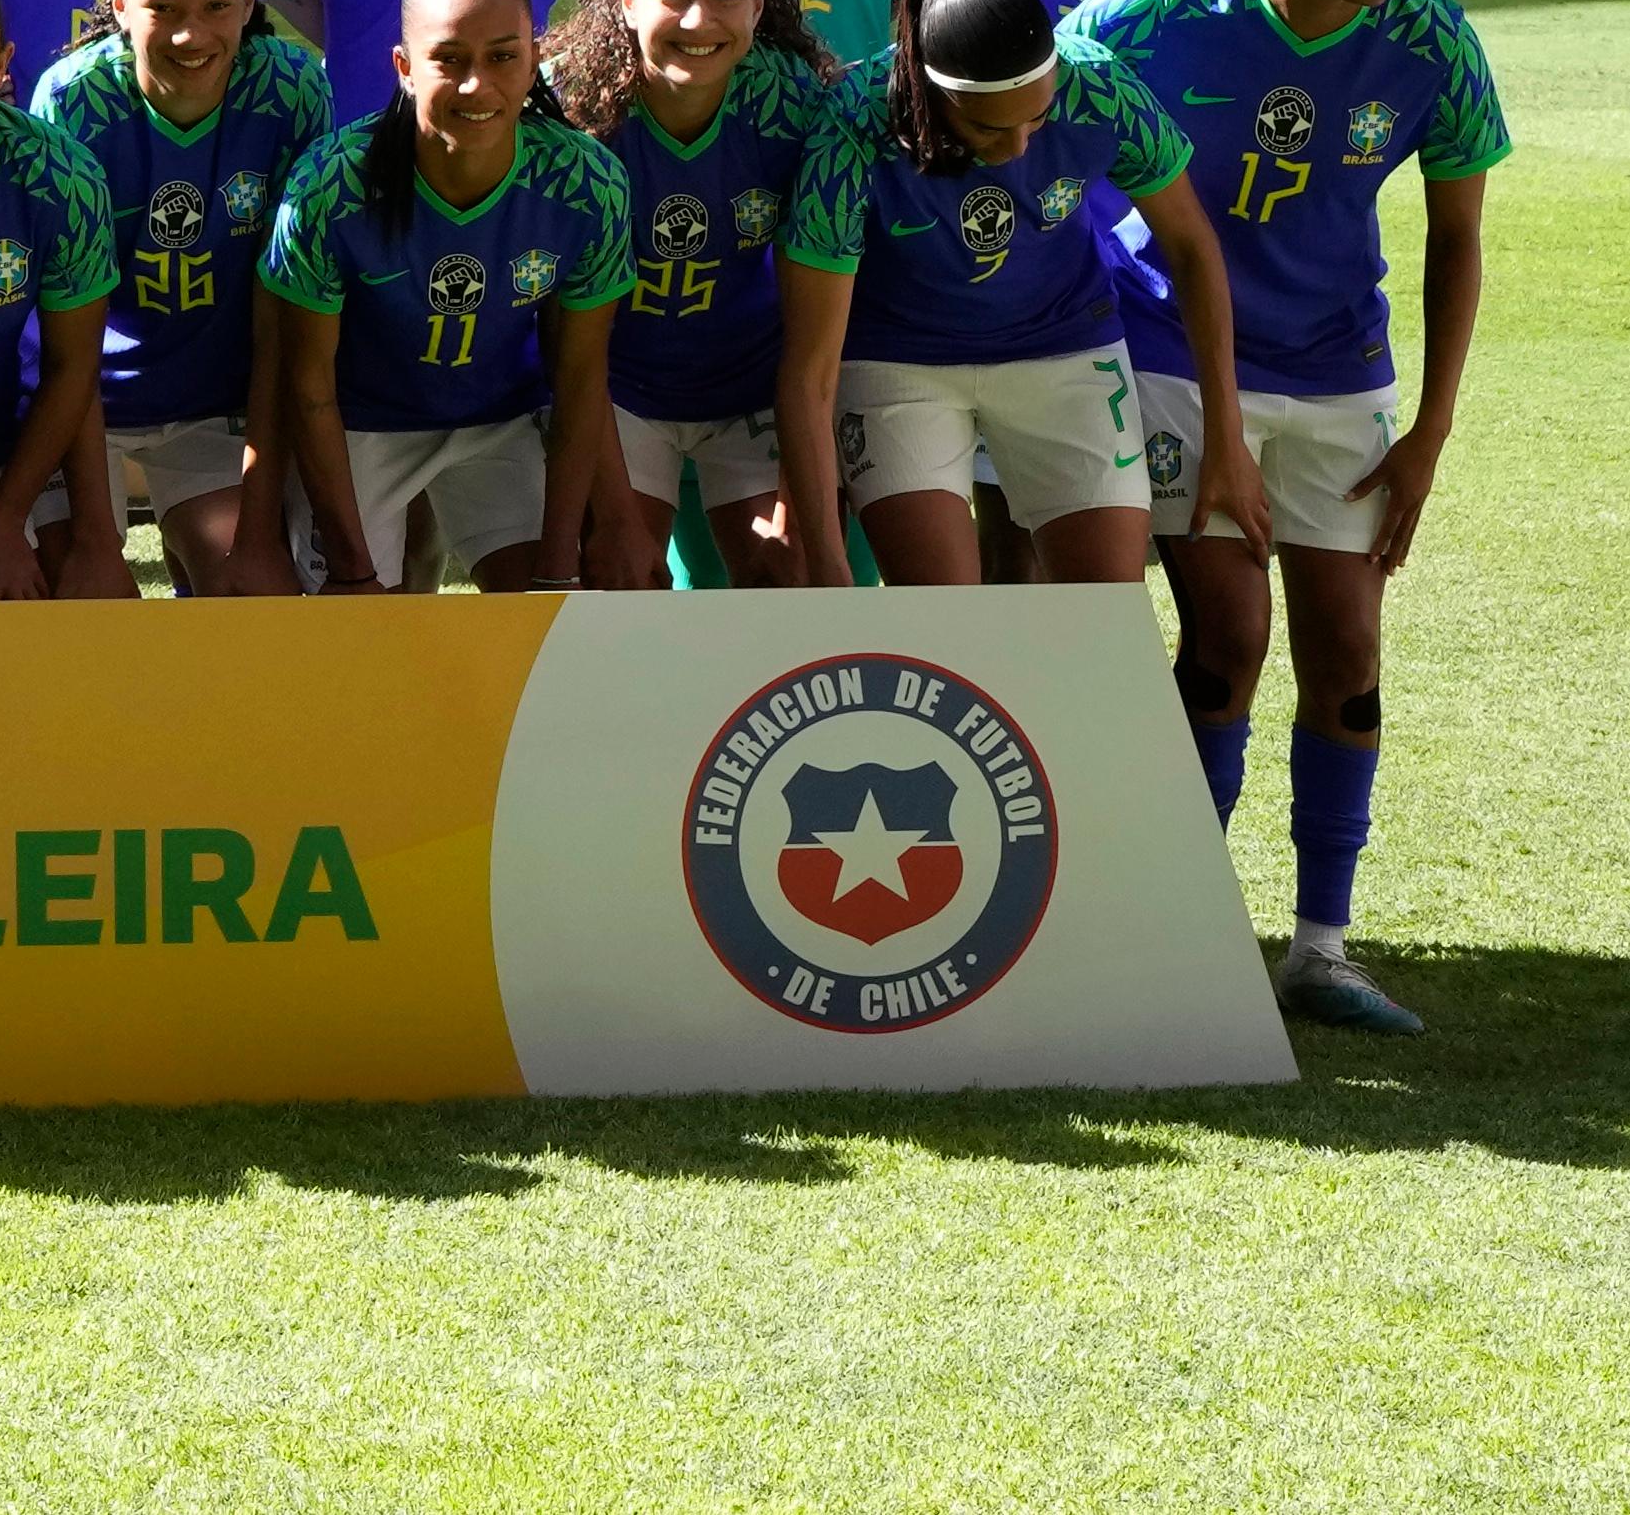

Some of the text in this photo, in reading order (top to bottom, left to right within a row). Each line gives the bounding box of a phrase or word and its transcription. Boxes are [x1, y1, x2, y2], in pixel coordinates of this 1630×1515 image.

[1228, 151, 1312, 224] 17
[1341, 154, 1384, 166] BRASIL
[133, 249, 215, 316] 26
[630, 257, 722, 319] 25
[418, 313, 477, 367] 11
[1092, 358, 1128, 432] 7
[1152, 488, 1188, 500] BRASIL
[695, 667, 1045, 846] FEDERACION DE FUTBOL
[782, 959, 968, 1022] DE CHILE
